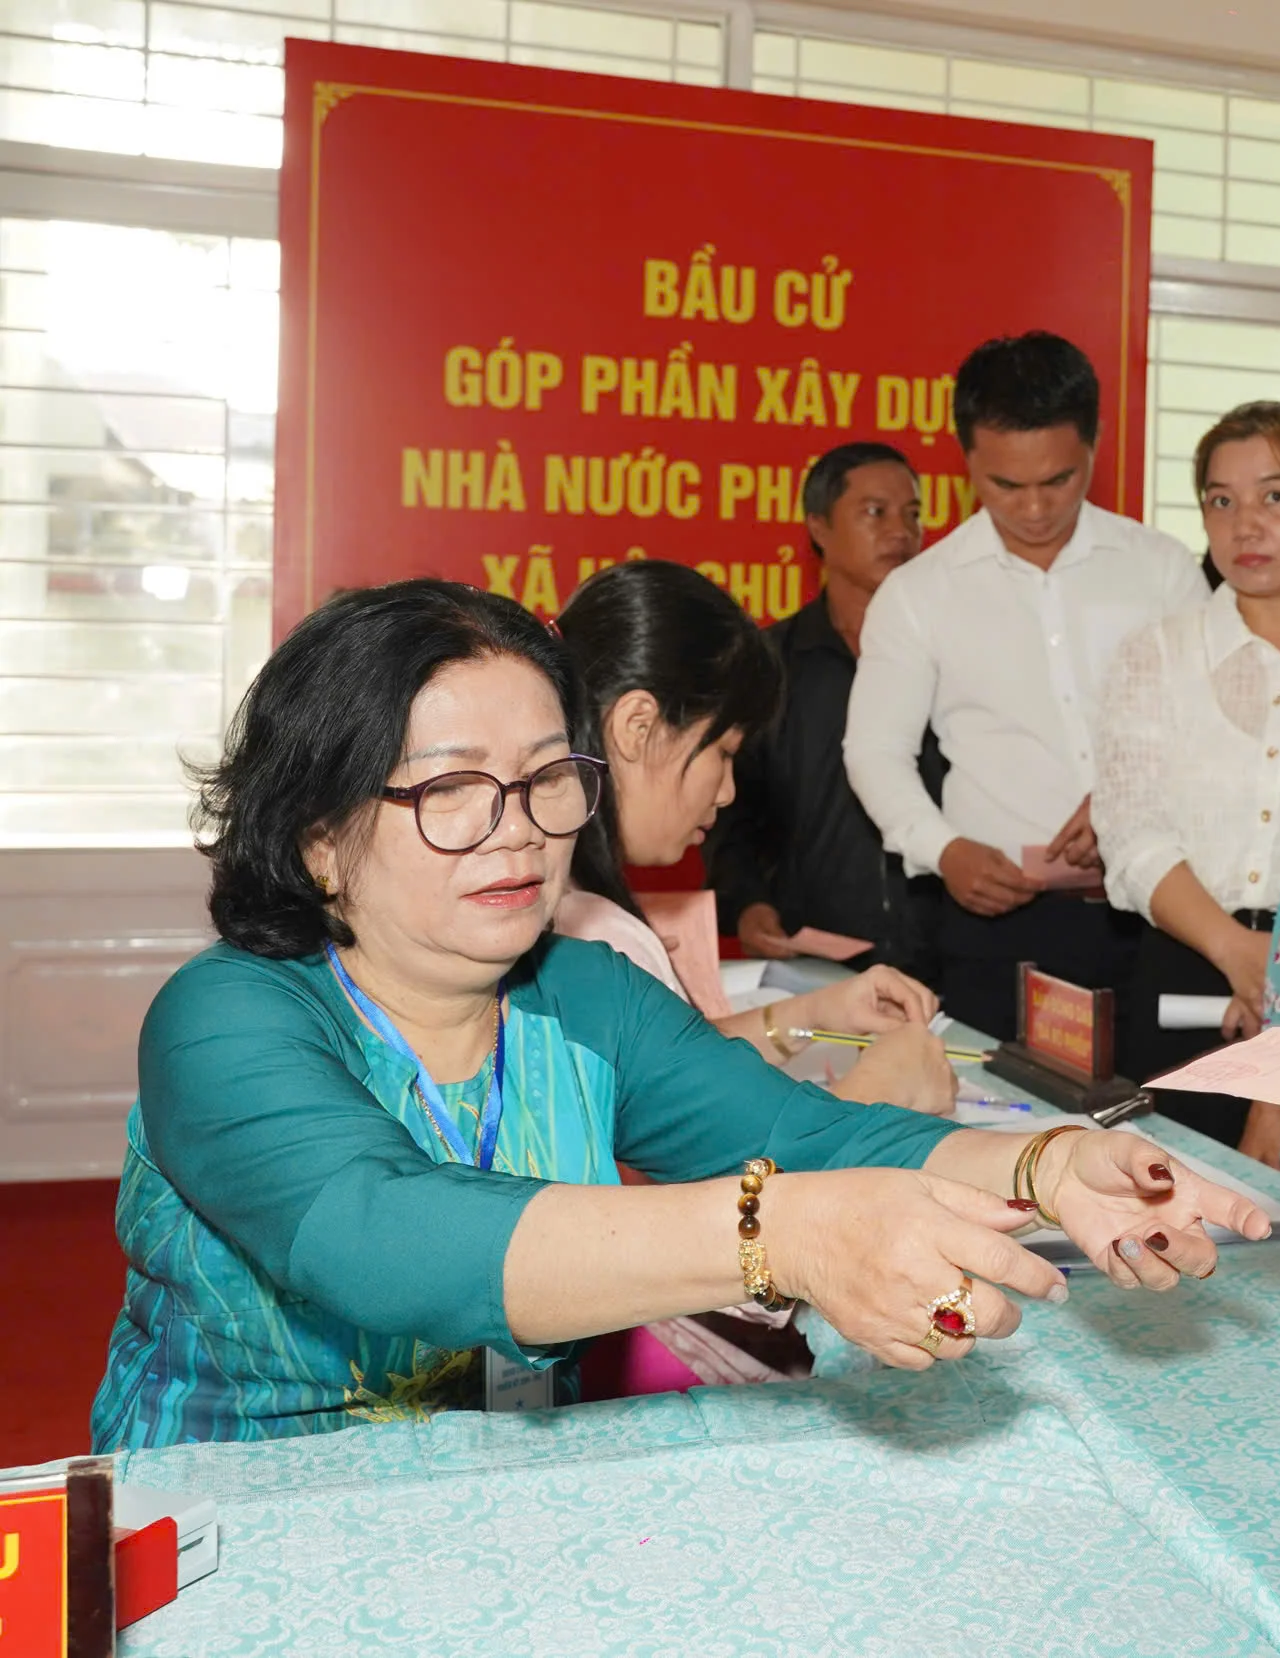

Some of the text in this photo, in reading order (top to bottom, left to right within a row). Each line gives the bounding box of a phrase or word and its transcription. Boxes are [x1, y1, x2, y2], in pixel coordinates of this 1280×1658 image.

[643, 243, 853, 331] BẦU CỬ
[444, 336, 957, 446] GÓP PHẦN XÂY DỰ
[402, 438, 526, 512] NHÀ
[544, 446, 702, 519] NƯỚC
[482, 544, 559, 615] XÃ
